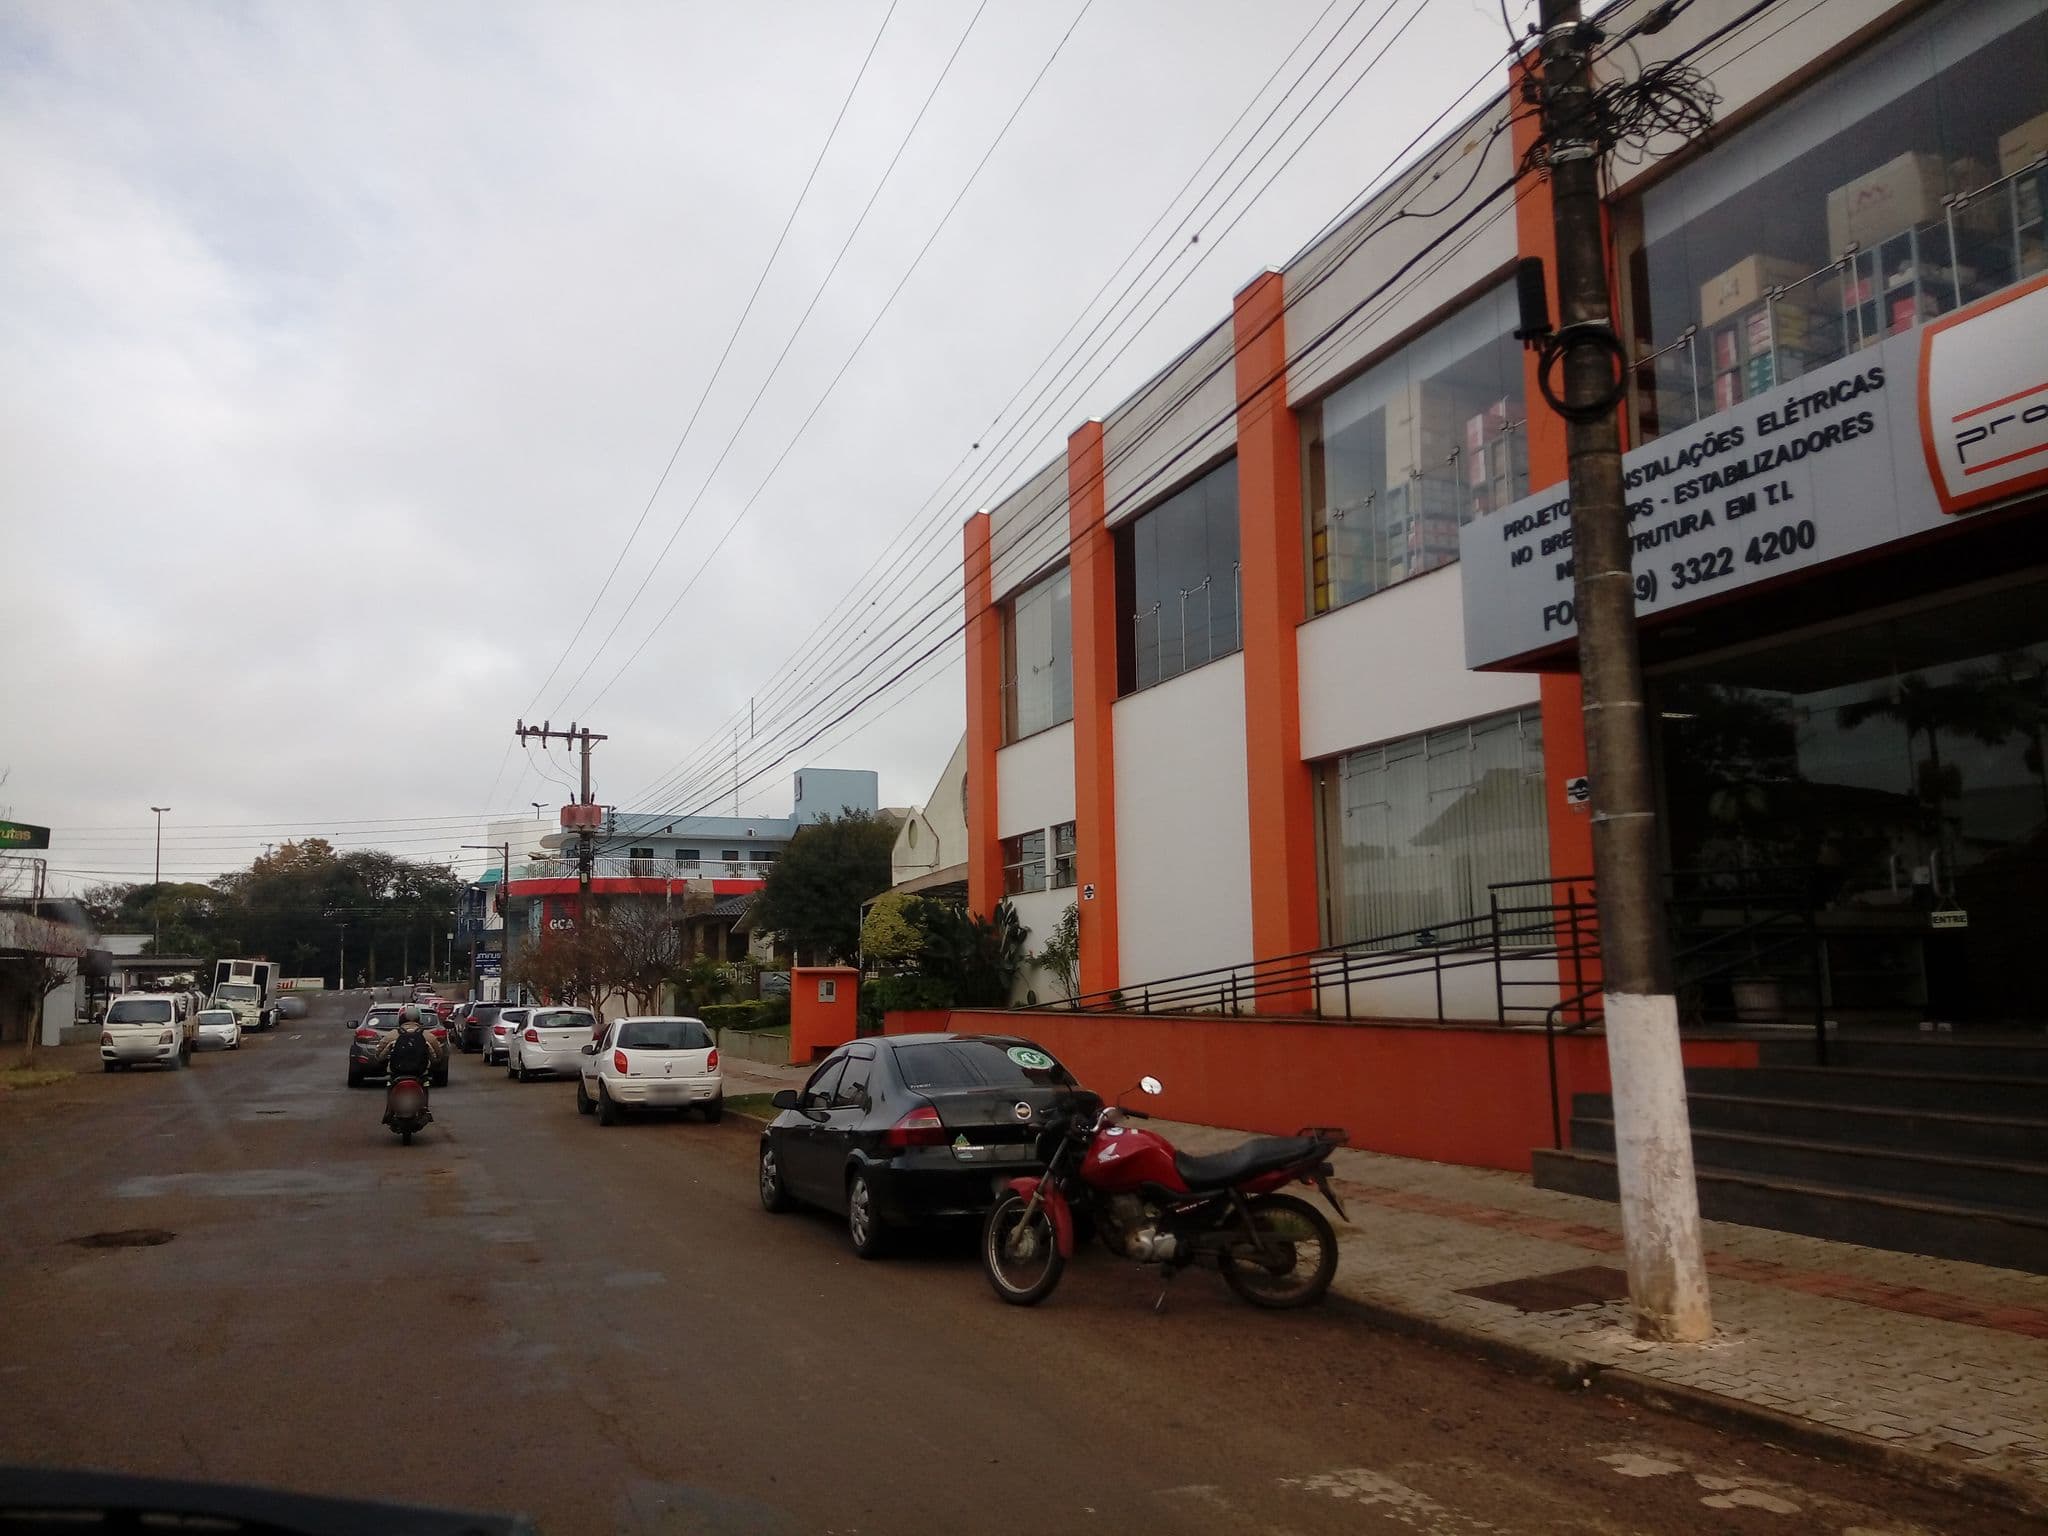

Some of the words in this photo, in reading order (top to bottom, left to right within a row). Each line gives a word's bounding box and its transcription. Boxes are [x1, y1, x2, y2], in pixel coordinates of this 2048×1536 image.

[1504, 498, 1573, 541] PROJETO
[1623, 425, 1744, 490] STALAÇÕES
[1757, 366, 1886, 436] ELÉTRICAS
[1511, 545, 1533, 567] NO
[1624, 497, 1654, 522] PS
[1674, 411, 1874, 504] ESTABILIZADORES
[1726, 492, 1757, 520] EM
[1671, 547, 1734, 589] 3322
[1745, 520, 1815, 564] 4200
